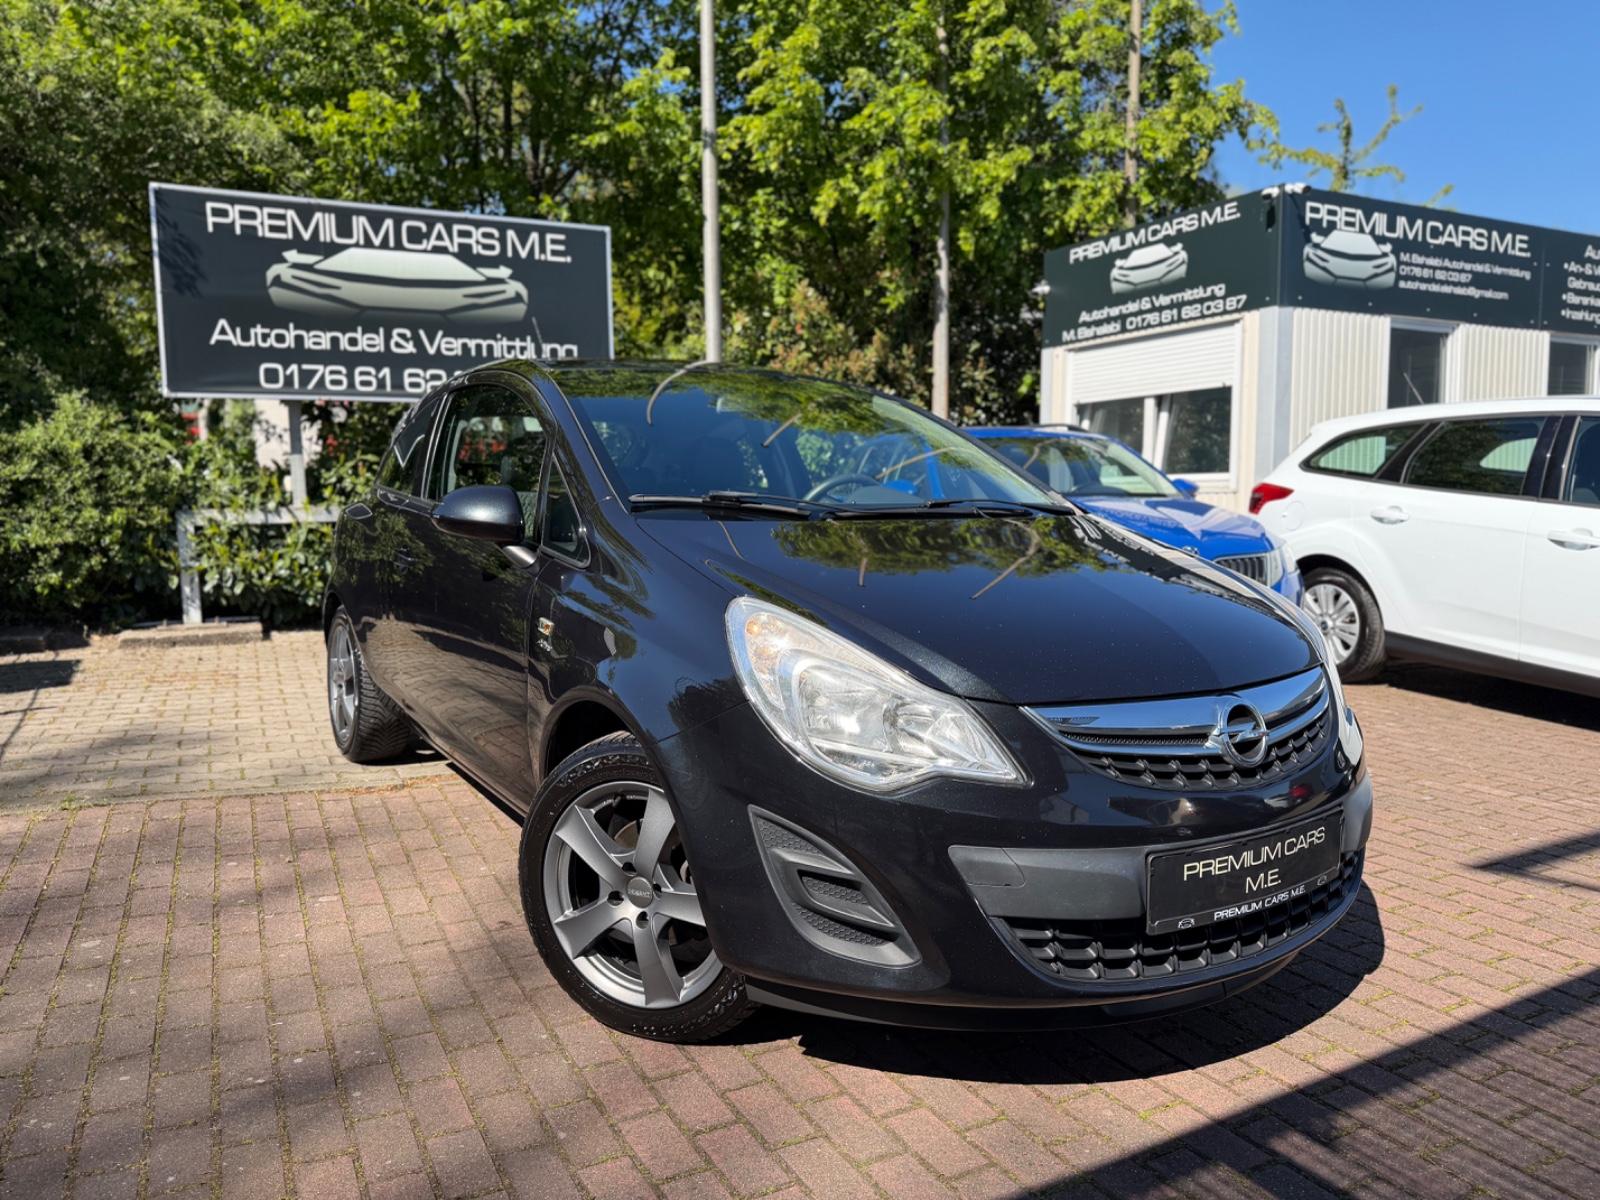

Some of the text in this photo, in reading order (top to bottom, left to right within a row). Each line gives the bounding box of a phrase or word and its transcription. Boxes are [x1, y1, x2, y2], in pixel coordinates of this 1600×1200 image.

[205, 202, 572, 263] PREMIUM CARS M.E.
[1069, 202, 1241, 264] PREMIUM CARS M.E.
[1305, 201, 1531, 257] PREMIUM CARS M.E.
[1078, 284, 1226, 323] Autohandel & Vermittlung
[1126, 313, 1161, 329] 0176
[1162, 309, 1178, 323] 61
[1181, 304, 1202, 319] 62
[1202, 299, 1224, 315] 03
[1225, 294, 1247, 310] 87
[209, 318, 384, 354] Autohandel
[390, 326, 417, 354] &
[259, 361, 348, 390] 0176
[354, 366, 392, 393] 61
[1183, 827, 1326, 881] PREMIUM CARS
[1245, 868, 1282, 894] M.E.
[1214, 901, 1263, 921] PREMIUM
[1264, 891, 1289, 906] CARS
